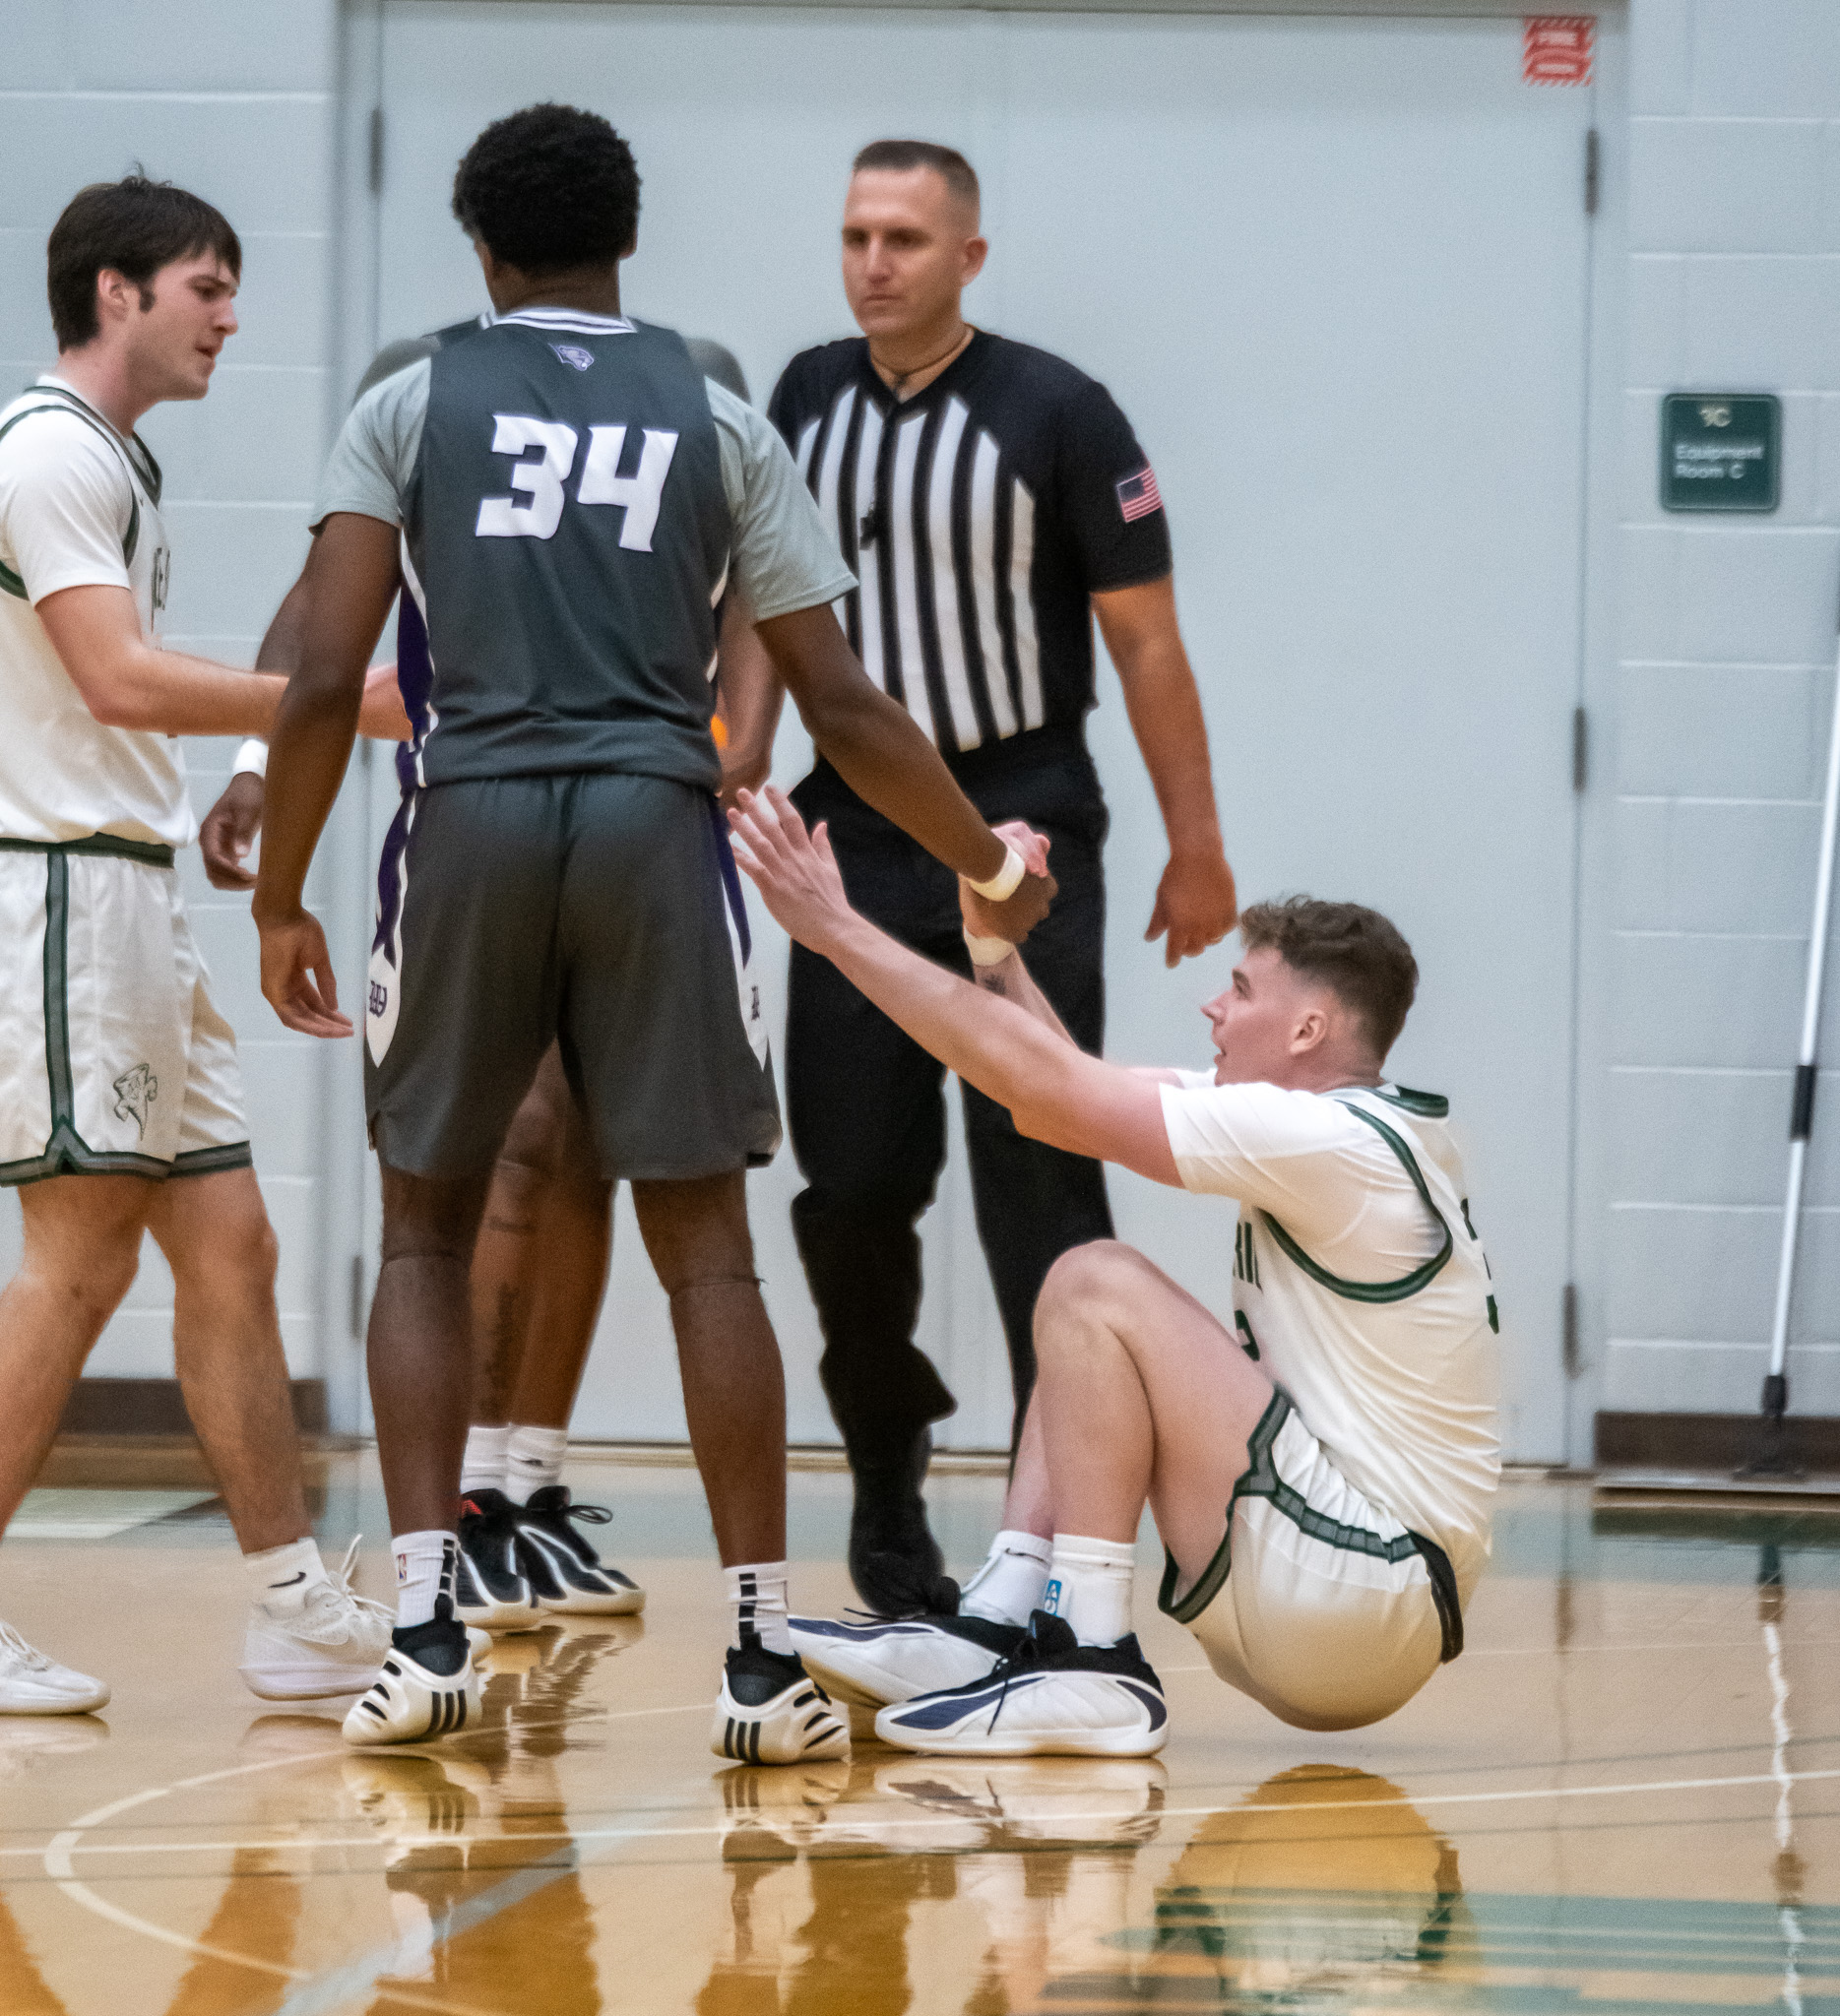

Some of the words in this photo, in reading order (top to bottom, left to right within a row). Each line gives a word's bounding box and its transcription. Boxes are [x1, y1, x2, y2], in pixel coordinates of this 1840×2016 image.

[476, 413, 678, 552] 34
[1675, 463, 1723, 478] Room
[1730, 463, 1745, 479] C
